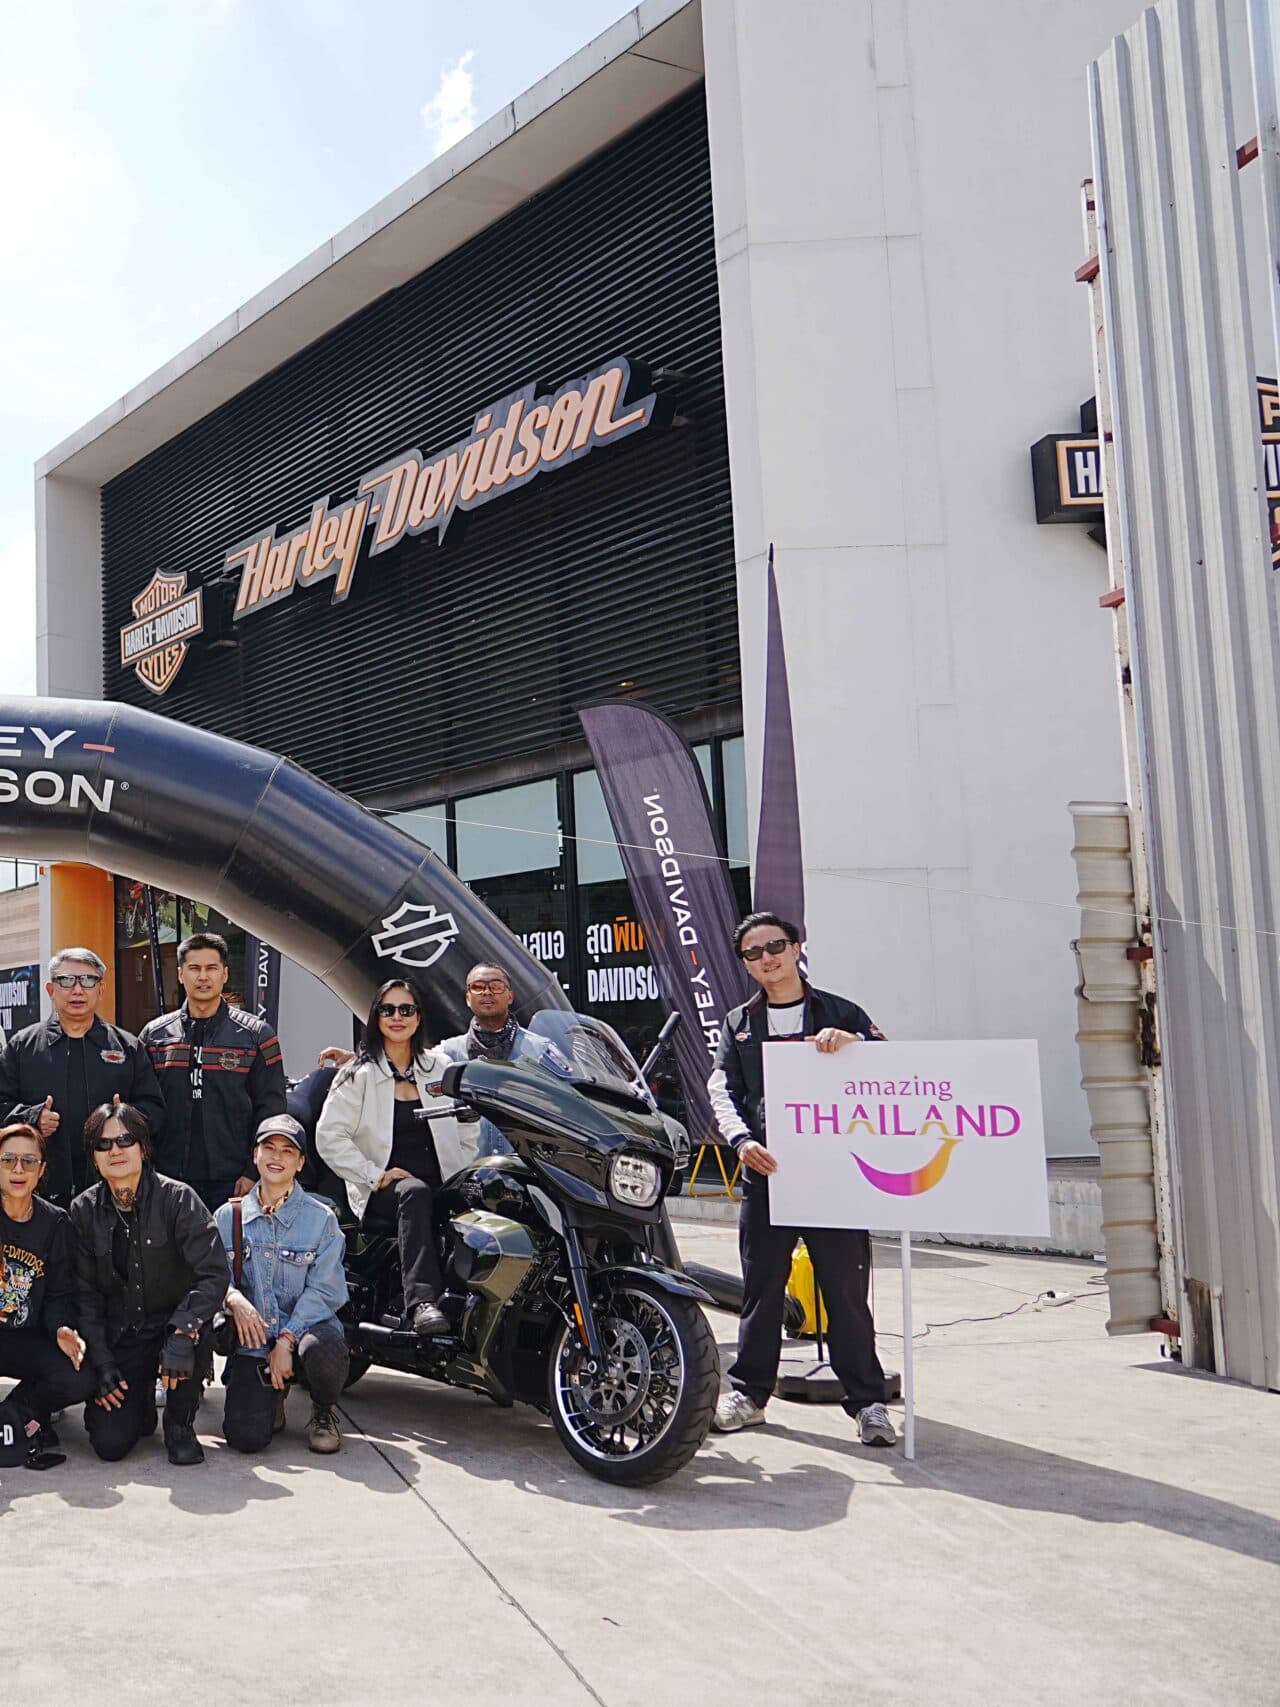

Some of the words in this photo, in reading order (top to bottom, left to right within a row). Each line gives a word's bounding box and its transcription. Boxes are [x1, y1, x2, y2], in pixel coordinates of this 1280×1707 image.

[227, 368, 645, 612] Harley-Davidson
[140, 582, 177, 616] MOTOR
[125, 600, 197, 657] HARLEY-DAVIDSON
[141, 644, 180, 684] CYCLES
[587, 965, 660, 1002] DAVIDSO
[844, 1075, 953, 1101] amazing
[785, 1103, 1021, 1137] THAILAND
